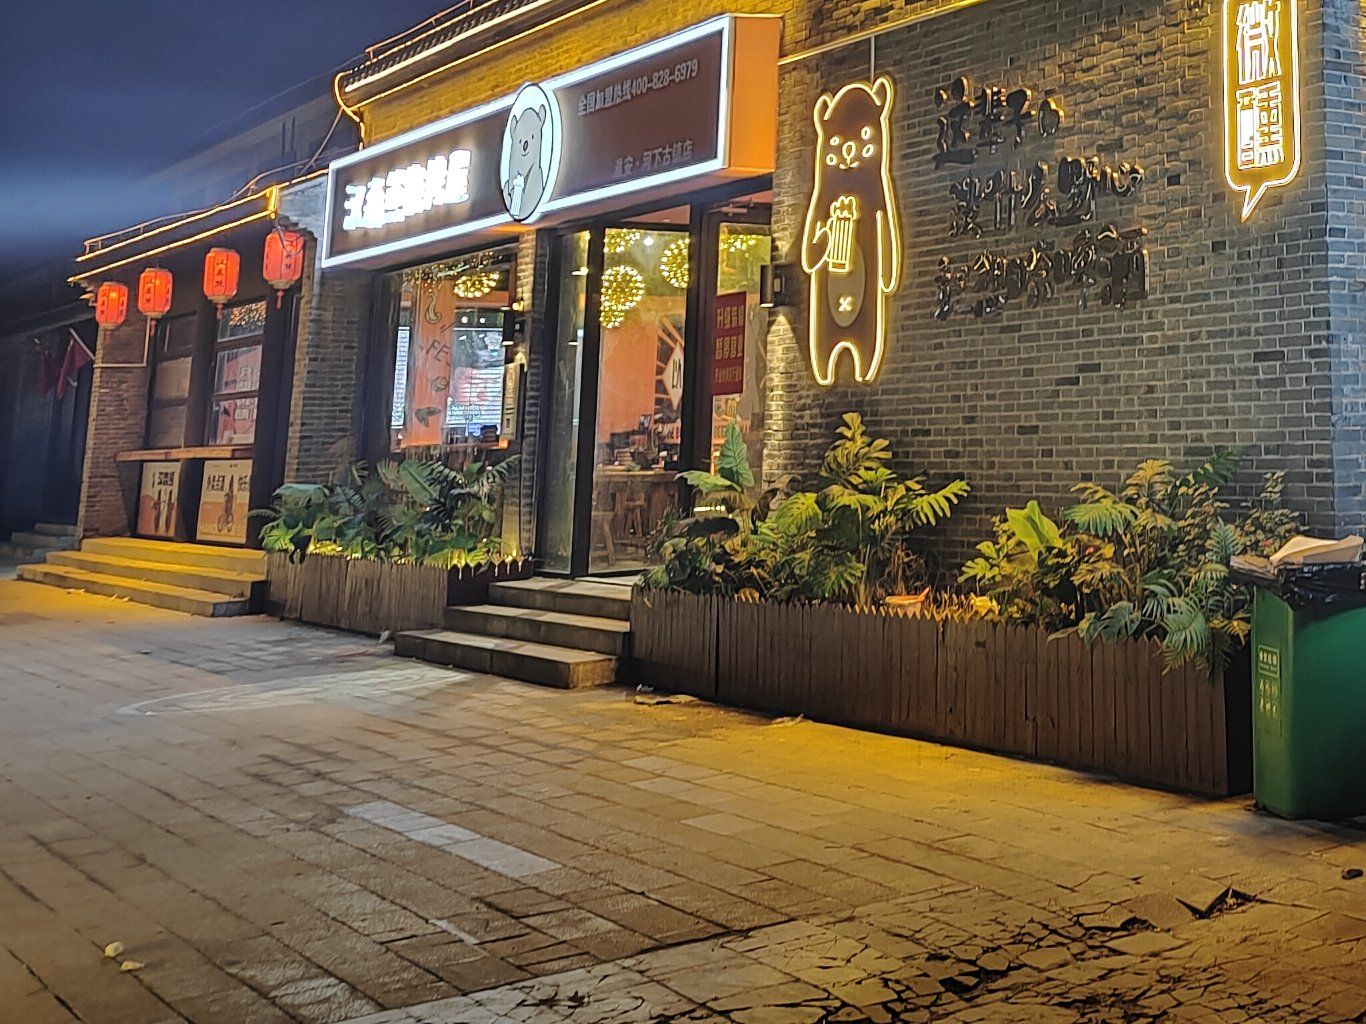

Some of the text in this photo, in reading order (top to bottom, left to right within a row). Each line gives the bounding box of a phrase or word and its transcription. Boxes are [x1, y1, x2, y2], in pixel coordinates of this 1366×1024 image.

[577, 58, 698, 116] 全国加盟热线400-828-6979
